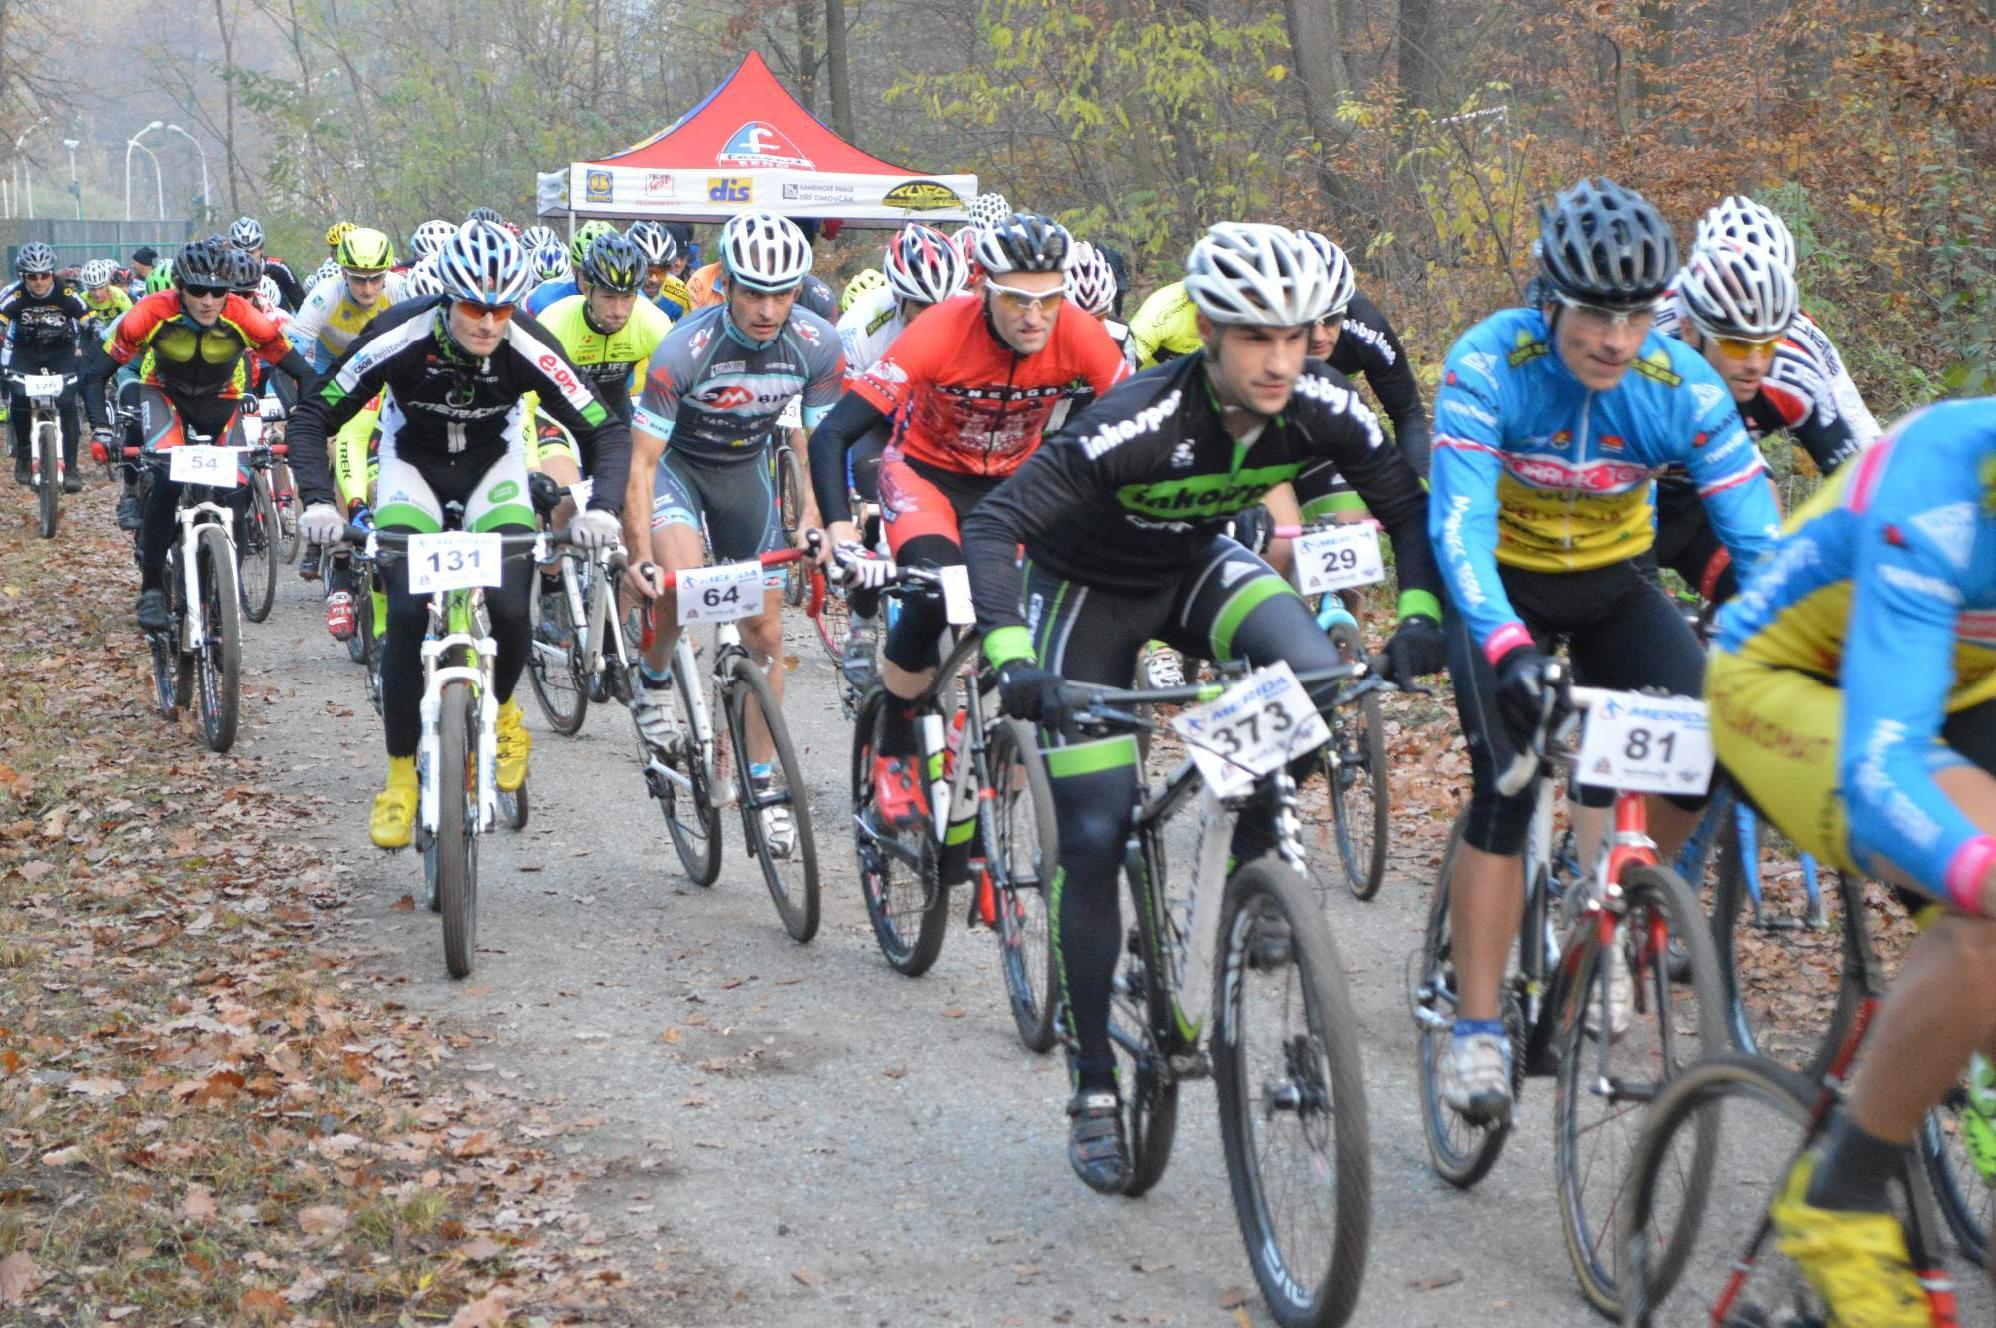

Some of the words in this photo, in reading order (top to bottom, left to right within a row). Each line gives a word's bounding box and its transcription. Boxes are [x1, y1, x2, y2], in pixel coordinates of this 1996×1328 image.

[709, 178, 750, 202] dis
[191, 456, 219, 471] 54
[340, 440, 352, 480] TREK
[427, 549, 481, 573] 131
[1322, 548, 1358, 573] 29
[703, 585, 740, 607] 64
[1212, 701, 1294, 755] 373
[1623, 727, 1677, 763] 81
